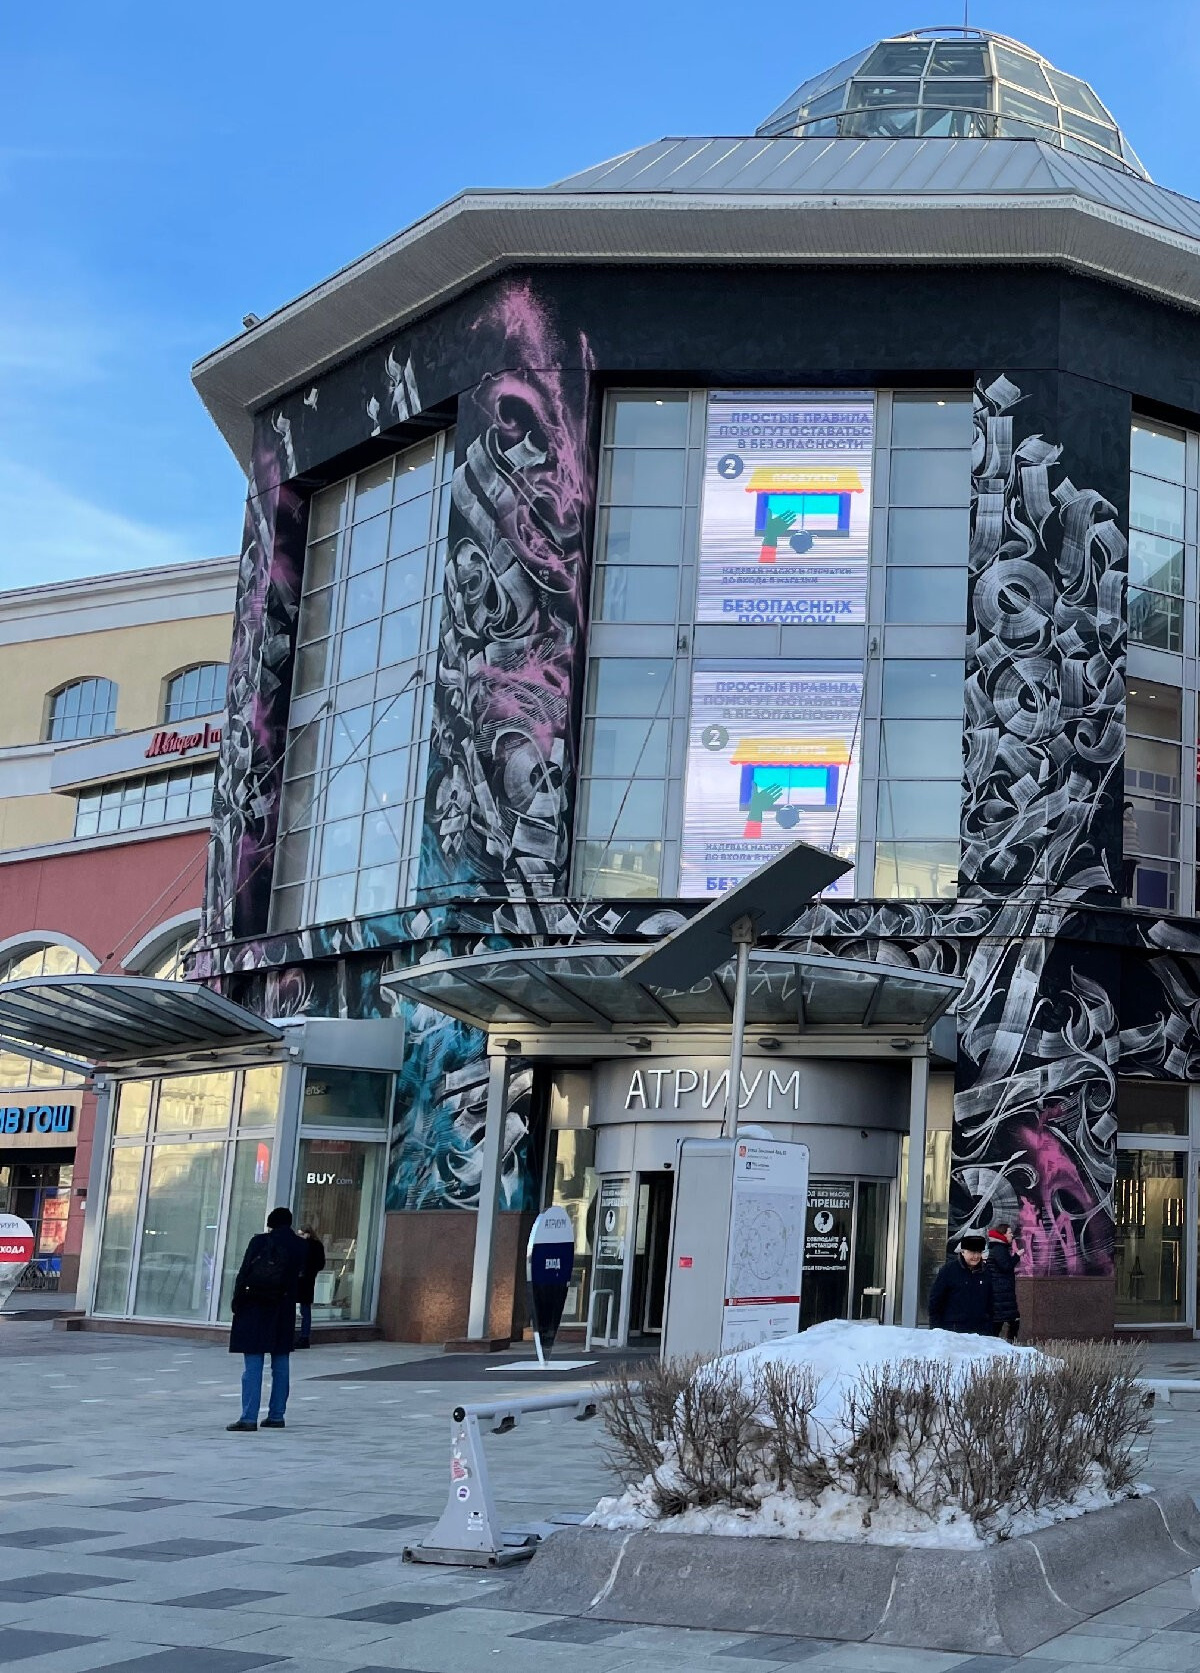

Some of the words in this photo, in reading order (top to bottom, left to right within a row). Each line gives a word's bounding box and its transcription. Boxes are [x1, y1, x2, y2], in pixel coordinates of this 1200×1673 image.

[731, 413, 799, 423] ПРОСТЫЕ
[804, 413, 870, 423] ПРАВИЛА
[719, 426, 786, 436] ПОМОГУТ
[750, 439, 864, 449] БЕЗОПАСНОСТИ
[724, 458, 736, 475] 2
[722, 599, 852, 613] БЕЗОПАСНЫХ
[716, 682, 786, 692] ПРОСТЫЕ
[708, 730, 721, 746] 2
[624, 1068, 800, 1109] АТРИУМ
[23, 1105, 75, 1133] ГОШ
[306, 1172, 336, 1184] BUY
[806, 1198, 850, 1209] АПРЕЩЕН
